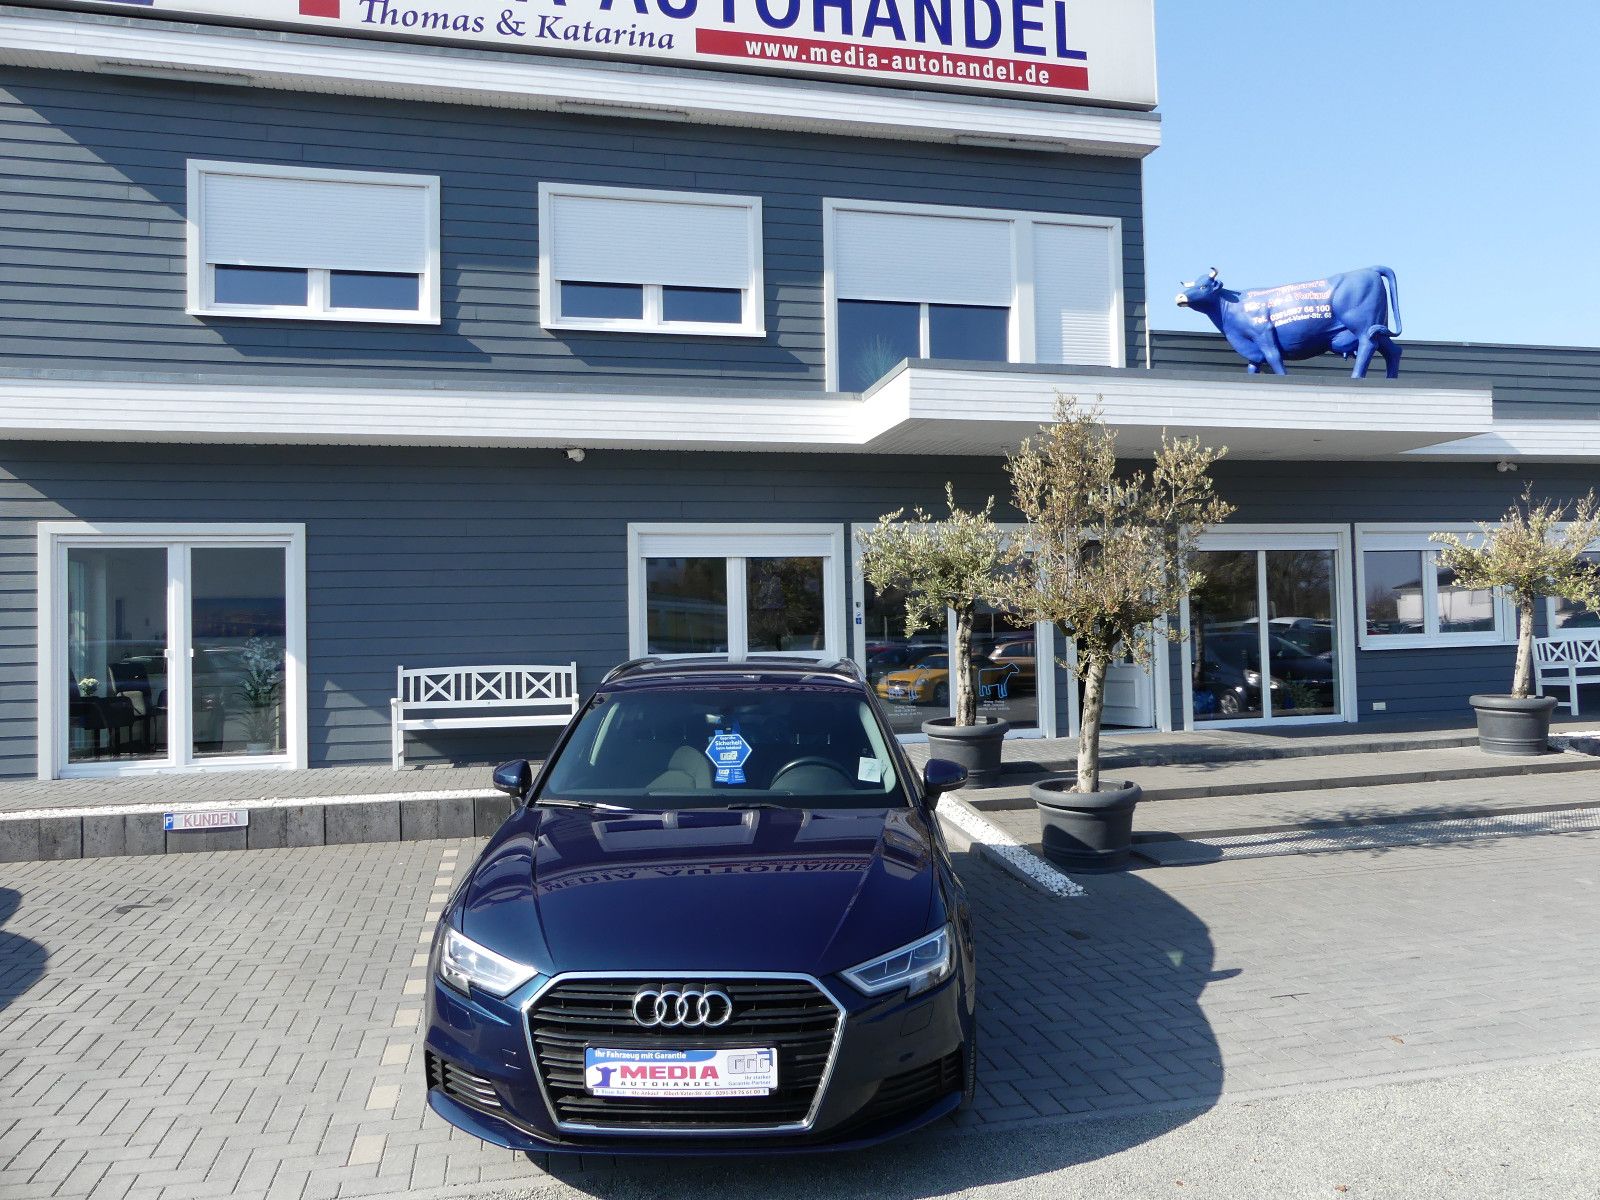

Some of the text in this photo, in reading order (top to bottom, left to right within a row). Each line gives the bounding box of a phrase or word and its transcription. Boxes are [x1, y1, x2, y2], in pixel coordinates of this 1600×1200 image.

[359, 0, 674, 49] Thomas & Katarina
[745, 40, 1049, 84] www.media-autohandel.de
[184, 812, 238, 827] KUNDEN
[606, 1051, 640, 1060] Fahrzeug
[620, 1065, 720, 1080] MEDIA
